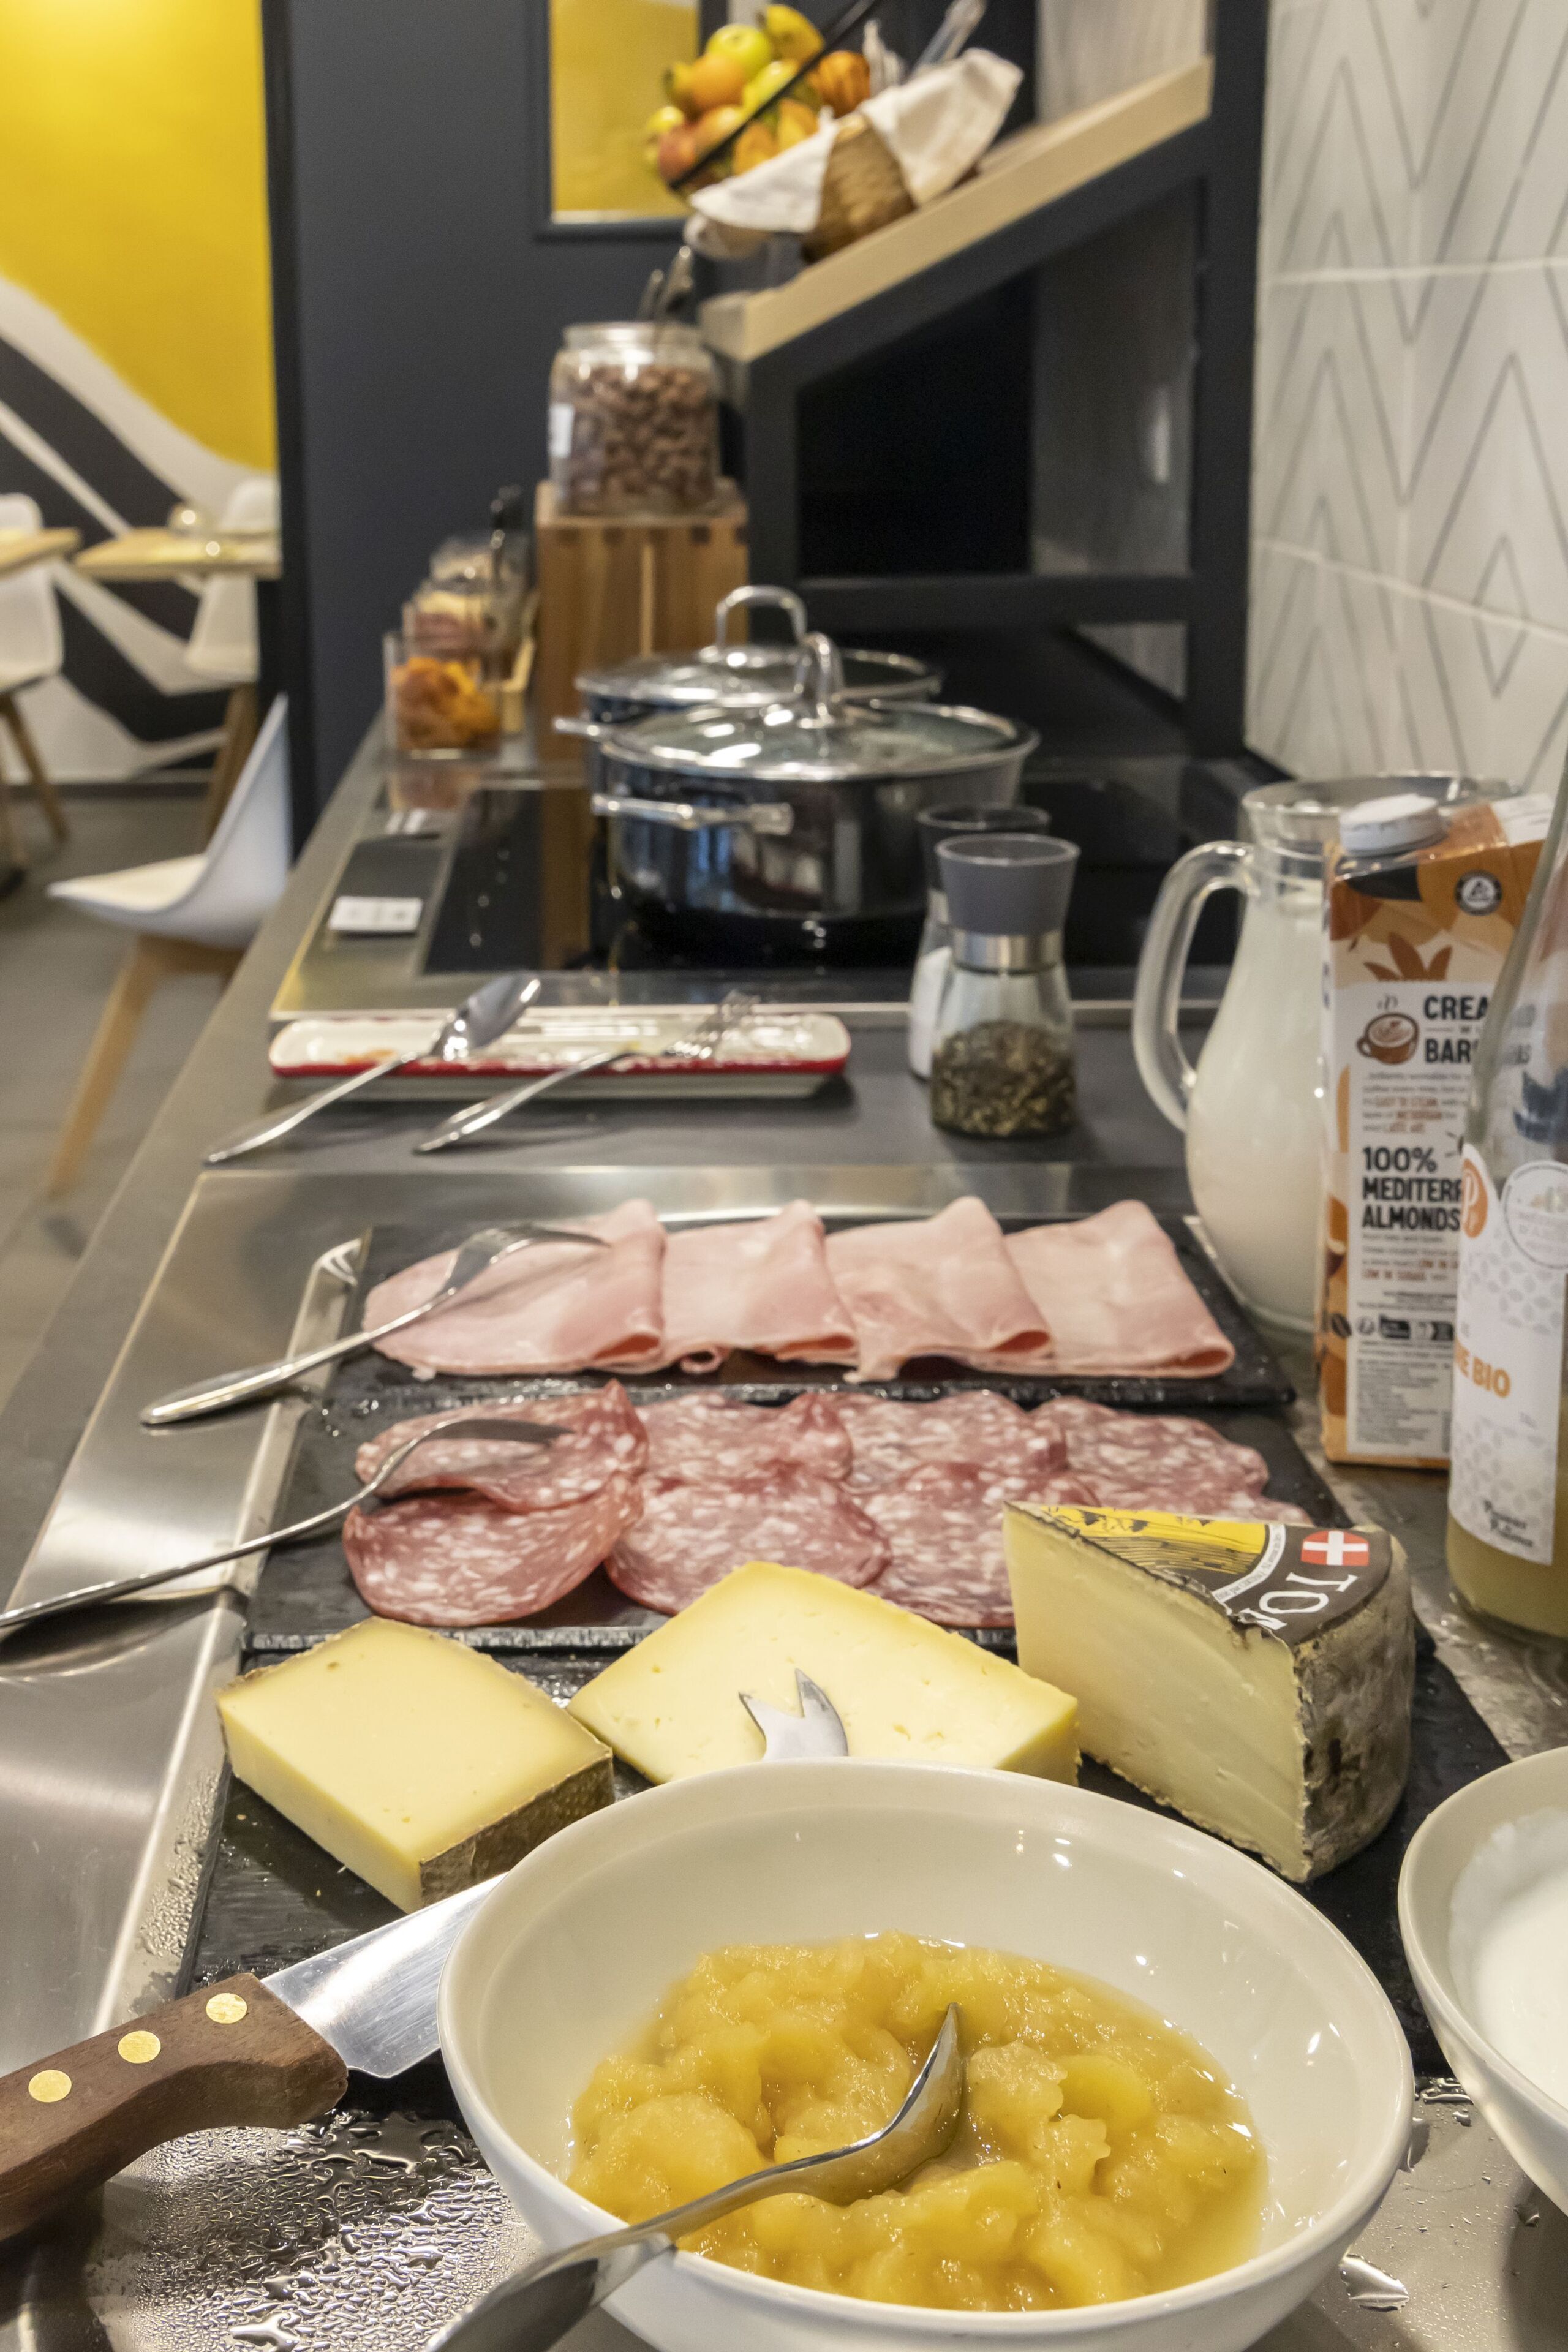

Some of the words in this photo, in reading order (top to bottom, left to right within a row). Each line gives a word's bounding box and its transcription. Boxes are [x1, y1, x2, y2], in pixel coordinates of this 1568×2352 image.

[1363, 1146, 1438, 1172] 100%
[1362, 1205, 1460, 1231] ALMONDS
[1473, 1356, 1511, 1398] BIO
